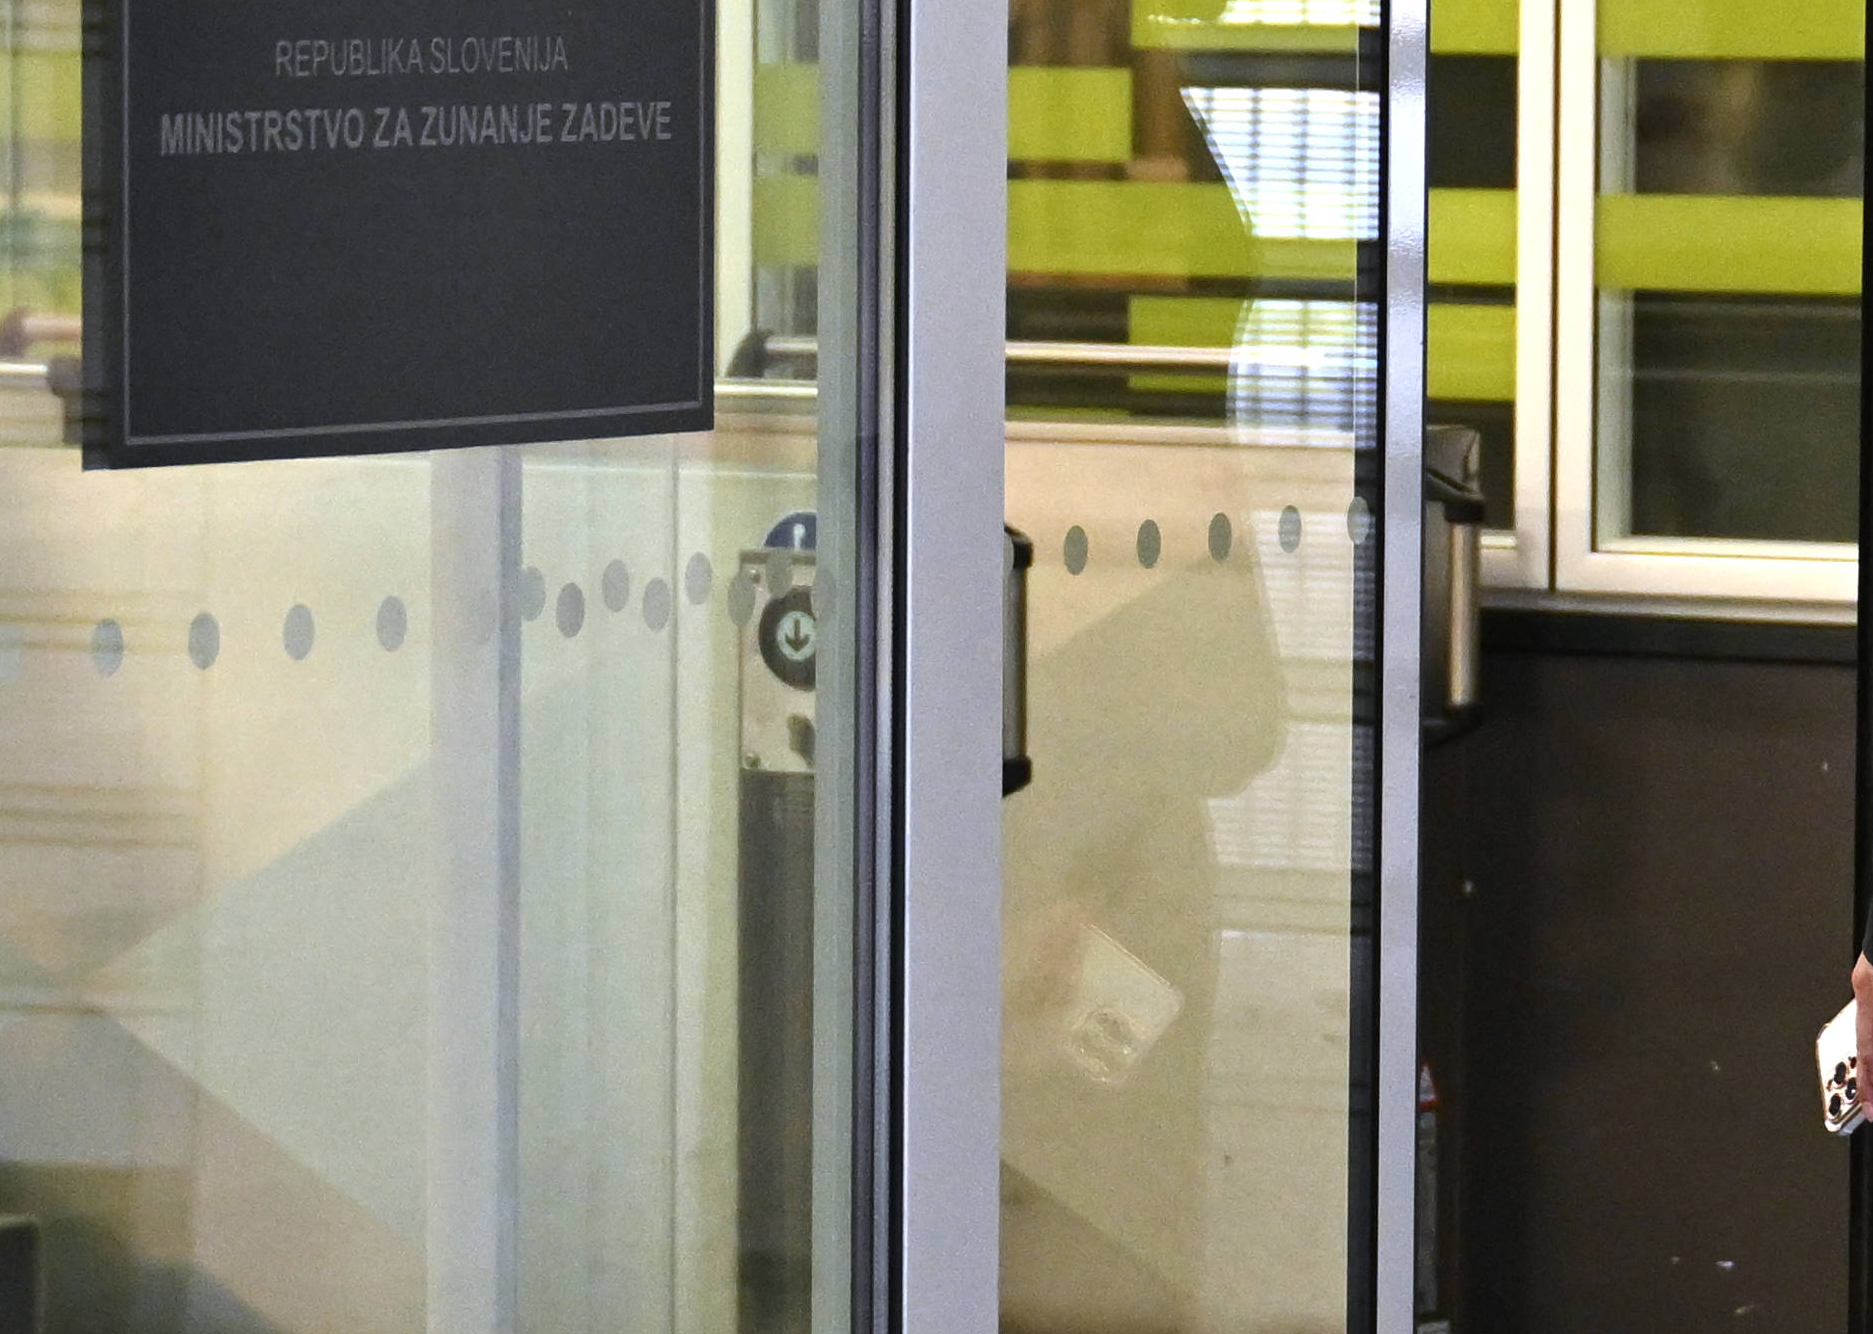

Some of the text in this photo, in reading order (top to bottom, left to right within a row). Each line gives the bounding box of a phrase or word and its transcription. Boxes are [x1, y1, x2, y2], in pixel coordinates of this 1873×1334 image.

[276, 35, 568, 77] REPUBLIKA SLOVENIJA
[160, 101, 672, 156] MINISTRSTVO ZA ZUNANJE ZADEVE
